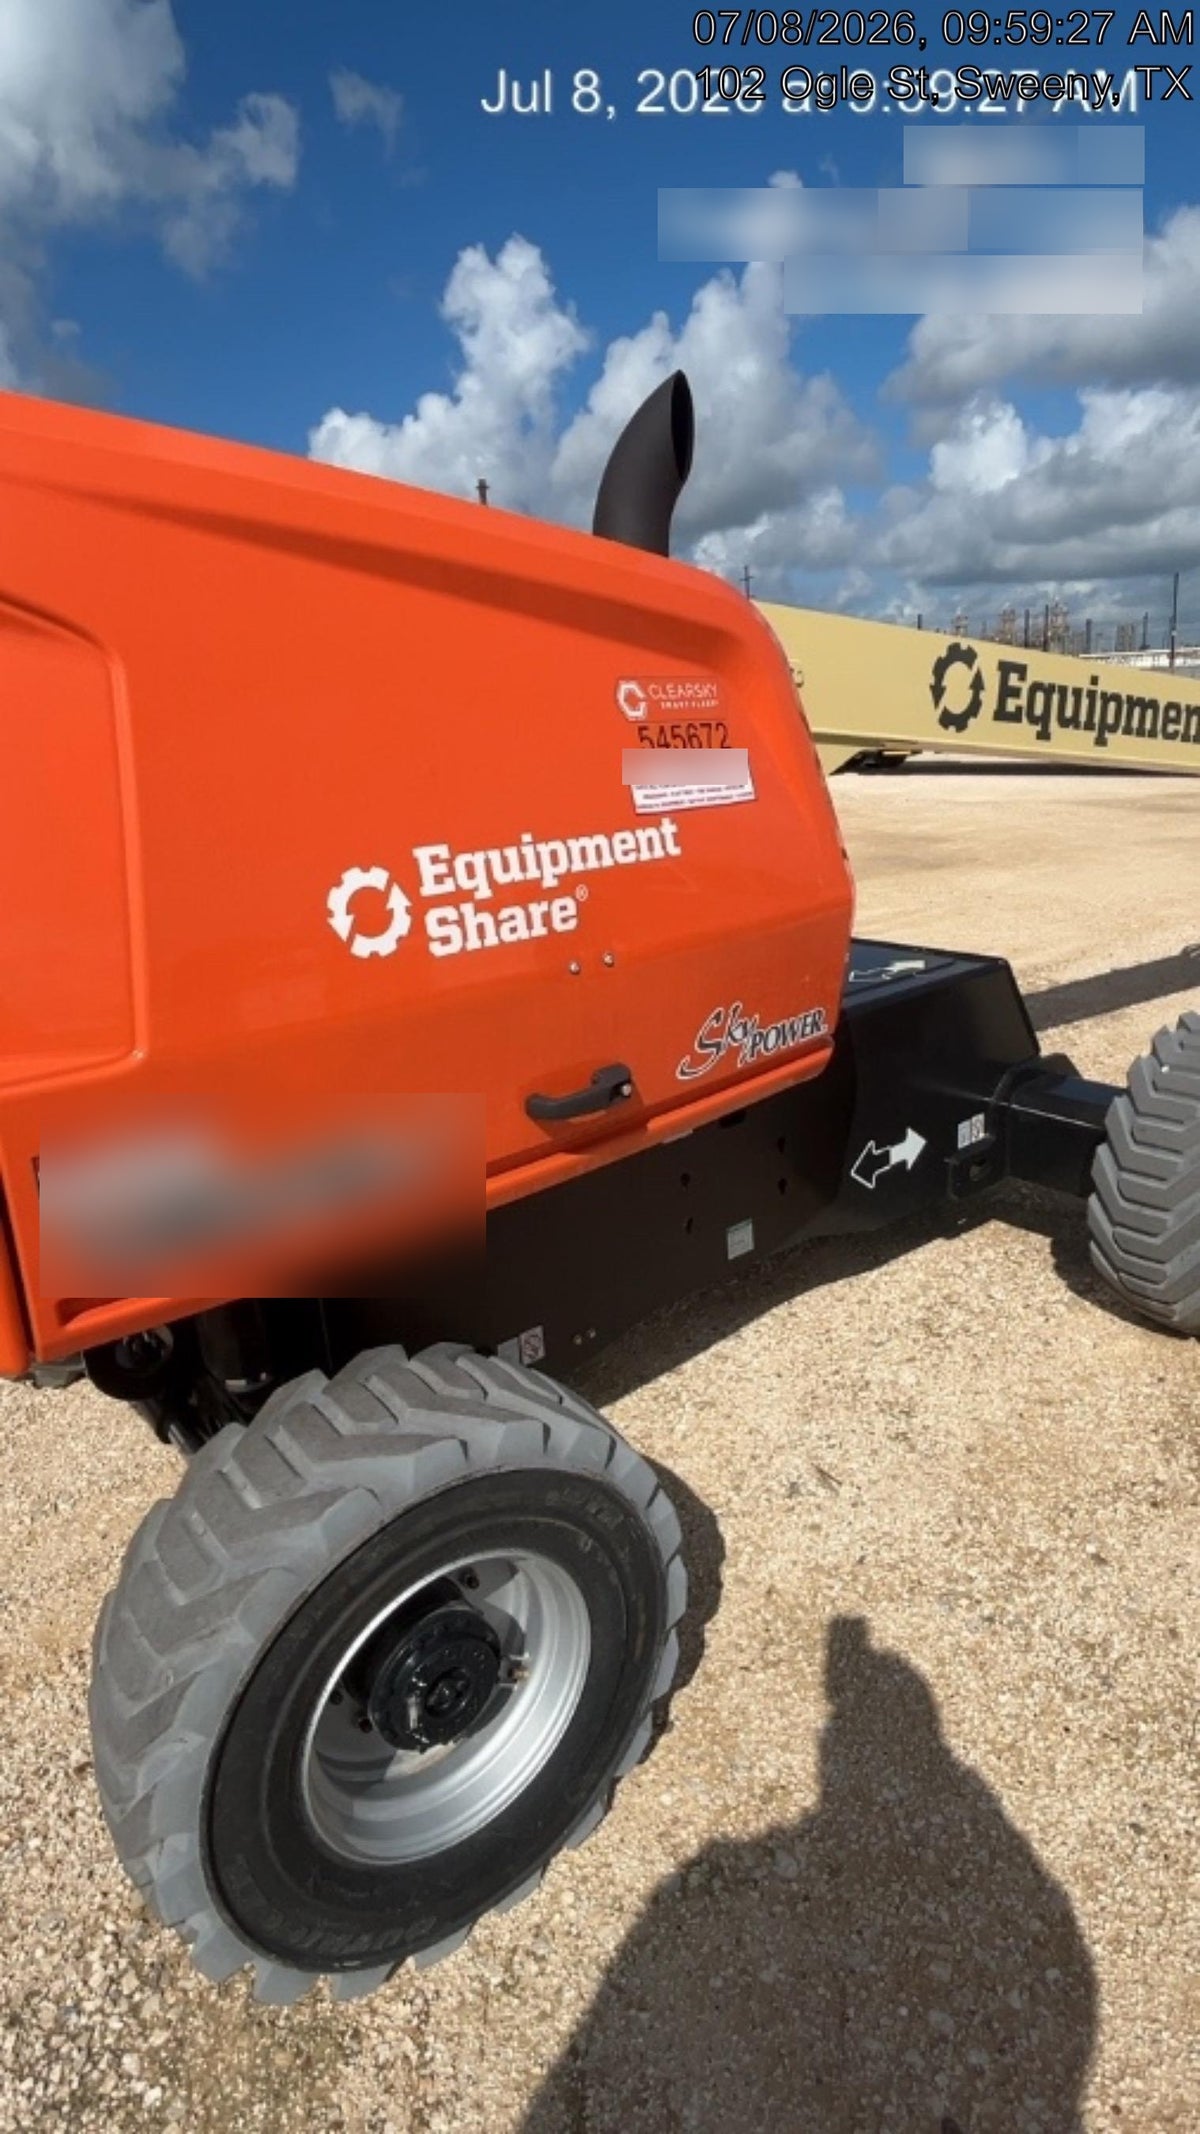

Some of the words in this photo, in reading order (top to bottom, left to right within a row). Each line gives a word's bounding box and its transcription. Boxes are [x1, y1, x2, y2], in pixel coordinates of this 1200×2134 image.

[648, 682, 718, 700] CLEARSKY
[637, 722, 732, 749] 545672
[412, 817, 682, 900] Equipment
